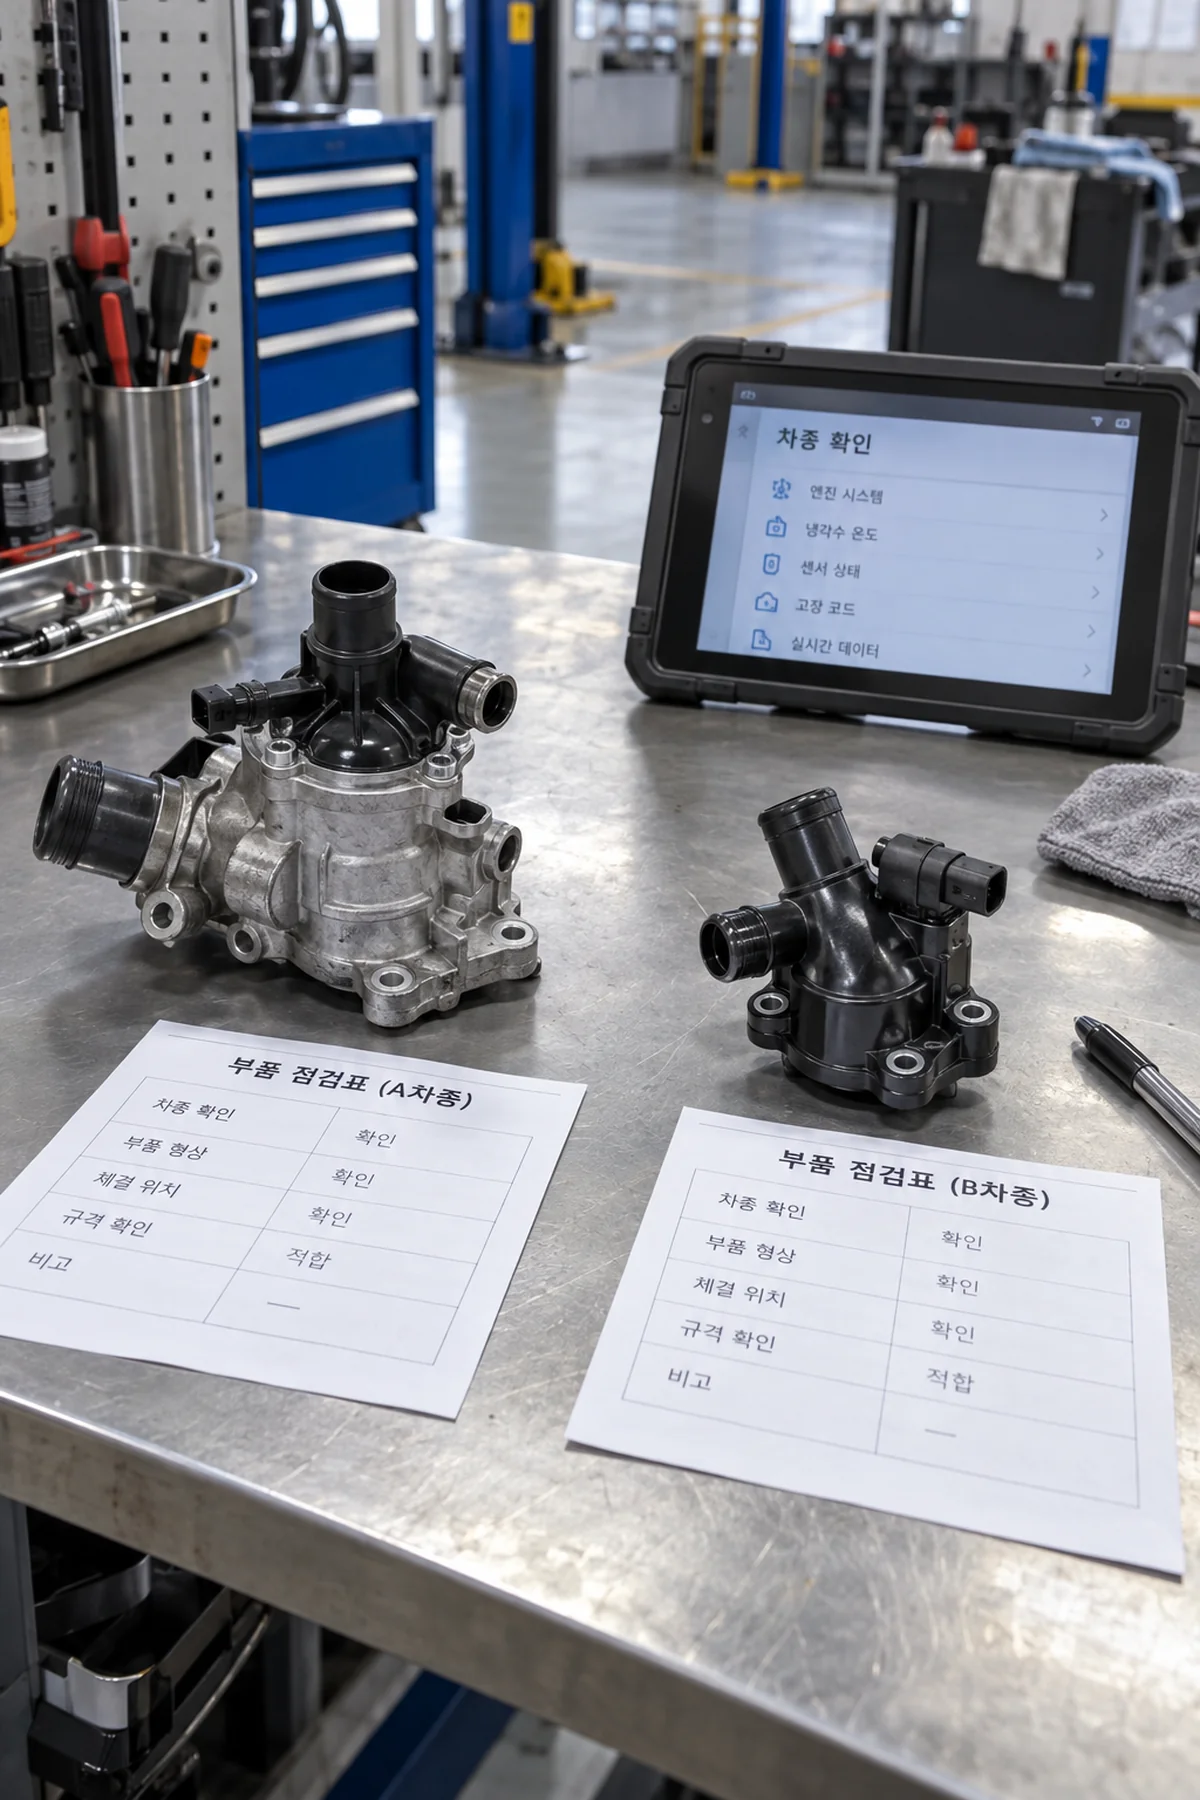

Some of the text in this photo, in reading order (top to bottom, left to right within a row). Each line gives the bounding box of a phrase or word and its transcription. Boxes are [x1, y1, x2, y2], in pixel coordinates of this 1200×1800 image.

[776, 427, 872, 456] 차종 확인
[810, 484, 884, 505] 엔진 시스템
[805, 522, 878, 542] 냉각수 온도
[800, 560, 861, 579] 센서 상태
[795, 598, 856, 617] 고장 코드
[791, 636, 880, 660] 실시간 데이터
[227, 1056, 473, 1111] 부품 점검표 (A차종)
[152, 1098, 236, 1123] 차종 확인
[123, 1135, 208, 1161] 부품 형상
[355, 1128, 397, 1149] 확인
[93, 1171, 182, 1199] 체결 위치
[331, 1168, 375, 1189] 확인
[778, 1149, 1050, 1211] 부품 점검표 (B차종)
[308, 1206, 353, 1229] 확인
[718, 1192, 806, 1221] 차종 확인
[62, 1208, 154, 1238] 규격 확인
[706, 1234, 797, 1265] 부품 형상
[941, 1230, 982, 1252] 확인
[28, 1252, 73, 1272] 비고
[286, 1247, 332, 1271] 적합
[693, 1276, 786, 1309] 체결 위치
[936, 1274, 979, 1297] 확인
[680, 1319, 776, 1354] 규격 확인
[931, 1319, 975, 1345] 확인
[667, 1368, 712, 1391] 비고
[927, 1368, 975, 1395] 적합
